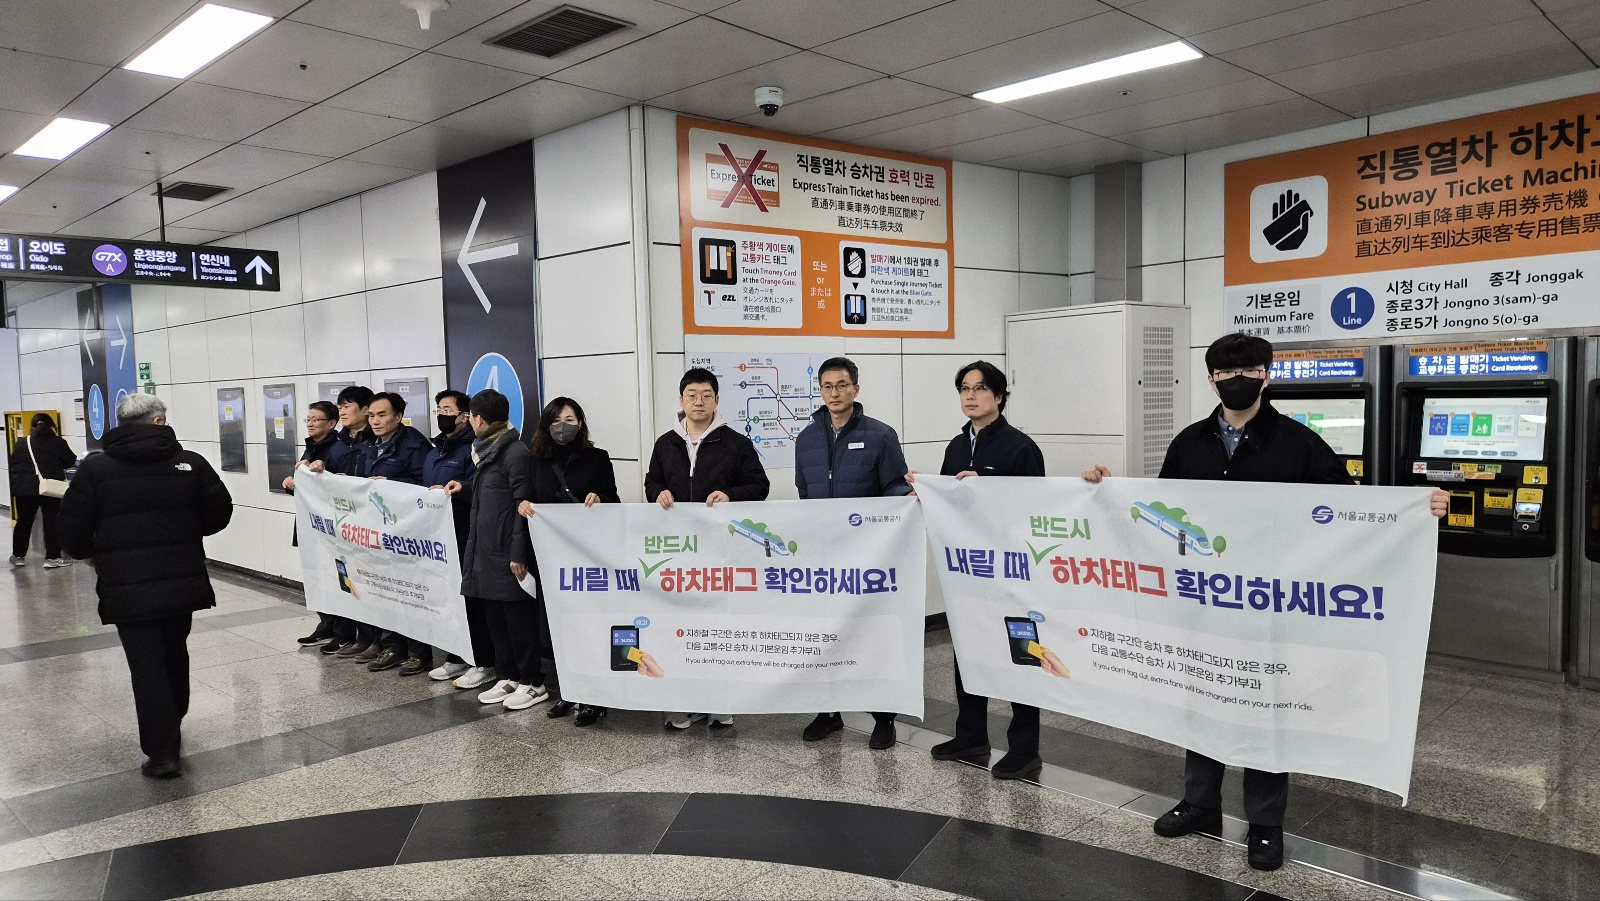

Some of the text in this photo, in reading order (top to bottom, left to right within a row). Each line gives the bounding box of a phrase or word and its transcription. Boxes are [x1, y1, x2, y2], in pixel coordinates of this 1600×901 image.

[1356, 114, 1600, 185] 직통열차 하차
[796, 154, 846, 178] 직통열차
[850, 162, 885, 183] 승차권
[888, 168, 910, 186] 효력
[914, 171, 935, 188] 만료
[748, 174, 776, 188] Ticket
[1356, 158, 1600, 212] Subway Ticket Machi
[792, 178, 941, 207] Express Train Ticket has been expired.
[1355, 188, 1588, 236] 直通列車降車専用券売機
[28, 240, 66, 255] 오이도
[741, 240, 794, 254] 주황색 게이트에
[29, 254, 49, 262] Oido
[95, 252, 122, 262] GTX
[134, 248, 230, 267] 운정중앙 연신내
[742, 253, 788, 265] 교통카드 태그
[870, 254, 902, 265] 발매기에서
[904, 256, 918, 267] 1회권
[106, 264, 114, 272] A
[760, 268, 782, 278] Tmoney
[812, 261, 828, 272] 또는
[870, 266, 890, 276] 파란색
[760, 278, 781, 286] Orange
[894, 280, 908, 288] Single
[1489, 270, 1522, 288] 종각
[1525, 268, 1584, 284] Jonggak
[810, 288, 832, 297] または
[1386, 280, 1413, 295] 시청
[1418, 278, 1468, 294] City Hall
[1246, 290, 1300, 310] 기본운임
[1346, 292, 1356, 314] 1
[1386, 296, 1440, 314] 종로3가
[1443, 292, 1558, 311] Jongno 3(sam)-ga
[1234, 310, 1314, 325] Minimum Fare
[1342, 316, 1362, 326] Line
[1386, 315, 1439, 332] 종로5가
[1442, 314, 1538, 330] Jongno 5(o)-ga
[1294, 360, 1318, 370] 발매기
[1460, 354, 1488, 364] 발매기
[1270, 370, 1318, 379] 통카드 충전기
[1418, 364, 1488, 375] 교통카드 충전기
[92, 390, 98, 418] 4
[332, 496, 356, 514] 반드시
[1338, 511, 1398, 523] 서울교통공사
[1030, 516, 1092, 540] 반드시
[342, 522, 382, 550] 하차태그
[382, 532, 448, 564] 확인하세요!
[644, 534, 698, 554] 반드시
[560, 566, 898, 595] 내릴 때 하차태그 확인하세요!
[945, 546, 1385, 621] 내릴 때 하차태그 확인하세요!
[686, 628, 708, 638] 지하철
[734, 630, 748, 639] 승차
[750, 630, 758, 640] 후
[760, 631, 802, 642] 하차태그되지
[804, 632, 820, 642] 않은
[822, 633, 840, 642] 경우,
[686, 642, 821, 656] 다음 교통수단 승차 시 기본운임 추가부과
[1090, 628, 1116, 642] 지하철
[1144, 640, 1162, 653] 승차
[1164, 644, 1174, 655] 후
[1176, 646, 1234, 670] 하차태그되지
[1236, 660, 1260, 673] 않은
[1263, 662, 1291, 676] 경우,
[1092, 642, 1262, 690] 다음 교통수단 승차 시 기본운임 추가부과
[1126, 669, 1138, 678] tag
[1150, 676, 1168, 684] extra
[1169, 679, 1184, 688] fare
[1184, 684, 1194, 692] will
[1206, 690, 1236, 704] charged
[1251, 700, 1272, 708] your
[1273, 702, 1292, 710] next
[1294, 702, 1314, 712] ride.
